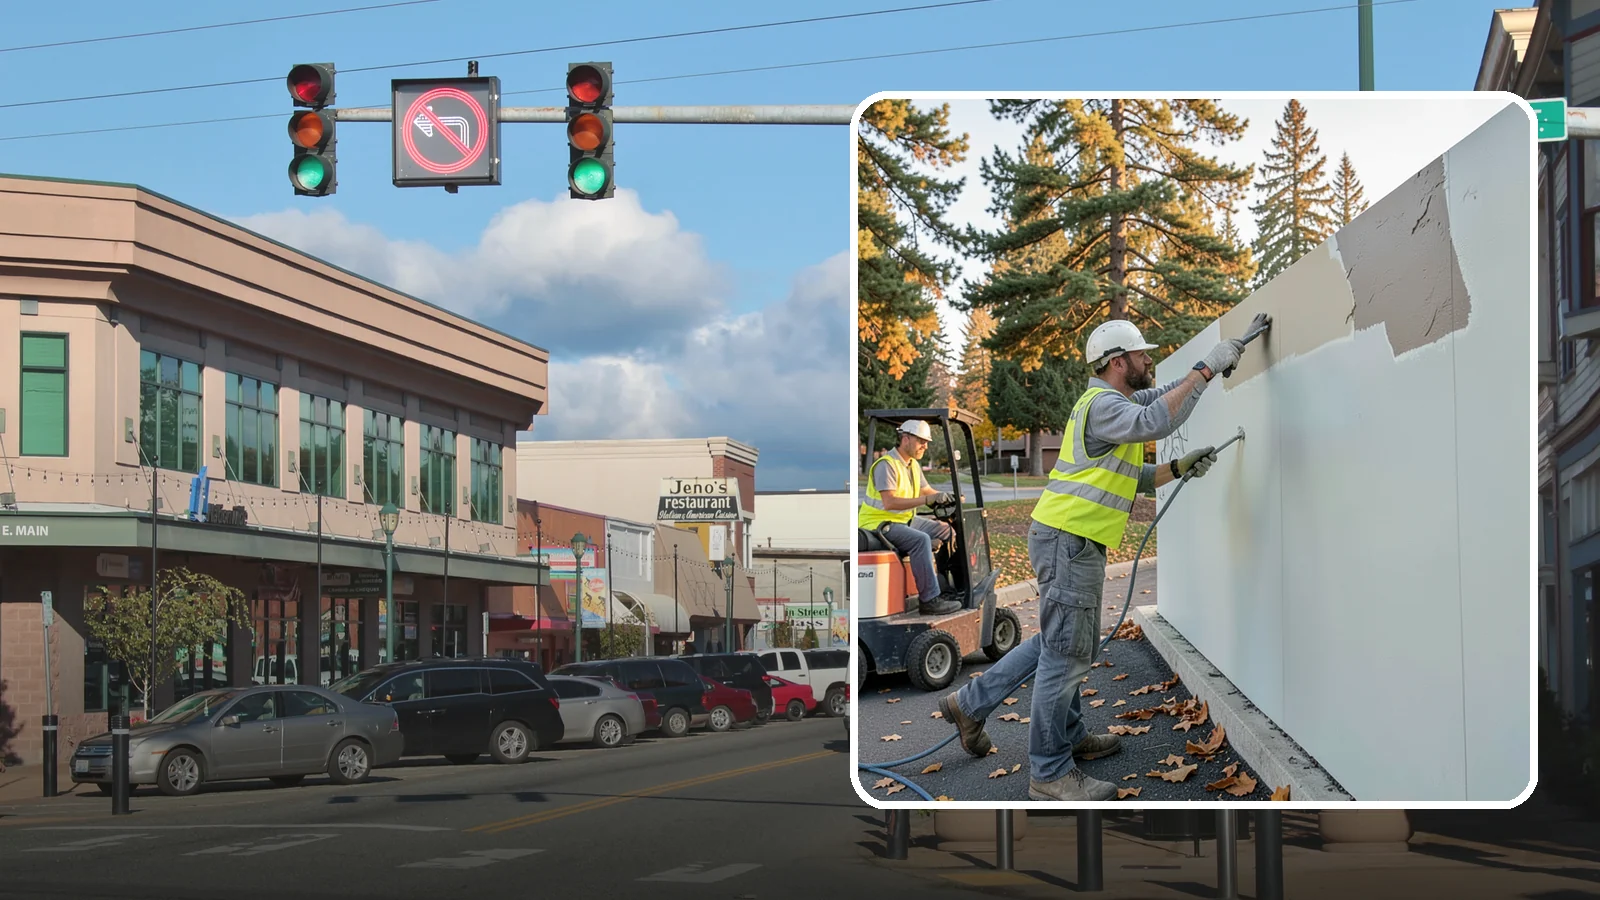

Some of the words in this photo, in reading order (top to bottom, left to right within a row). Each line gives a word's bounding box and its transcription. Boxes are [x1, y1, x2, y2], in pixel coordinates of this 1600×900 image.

[670, 480, 727, 494] Jeno's
[665, 496, 731, 509] restaurant
[659, 510, 681, 519] Italian
[686, 509, 714, 519] American
[715, 509, 737, 519] Cuisine
[2, 525, 13, 536] E.
[15, 525, 49, 536] MAIN
[797, 608, 828, 617] Street
